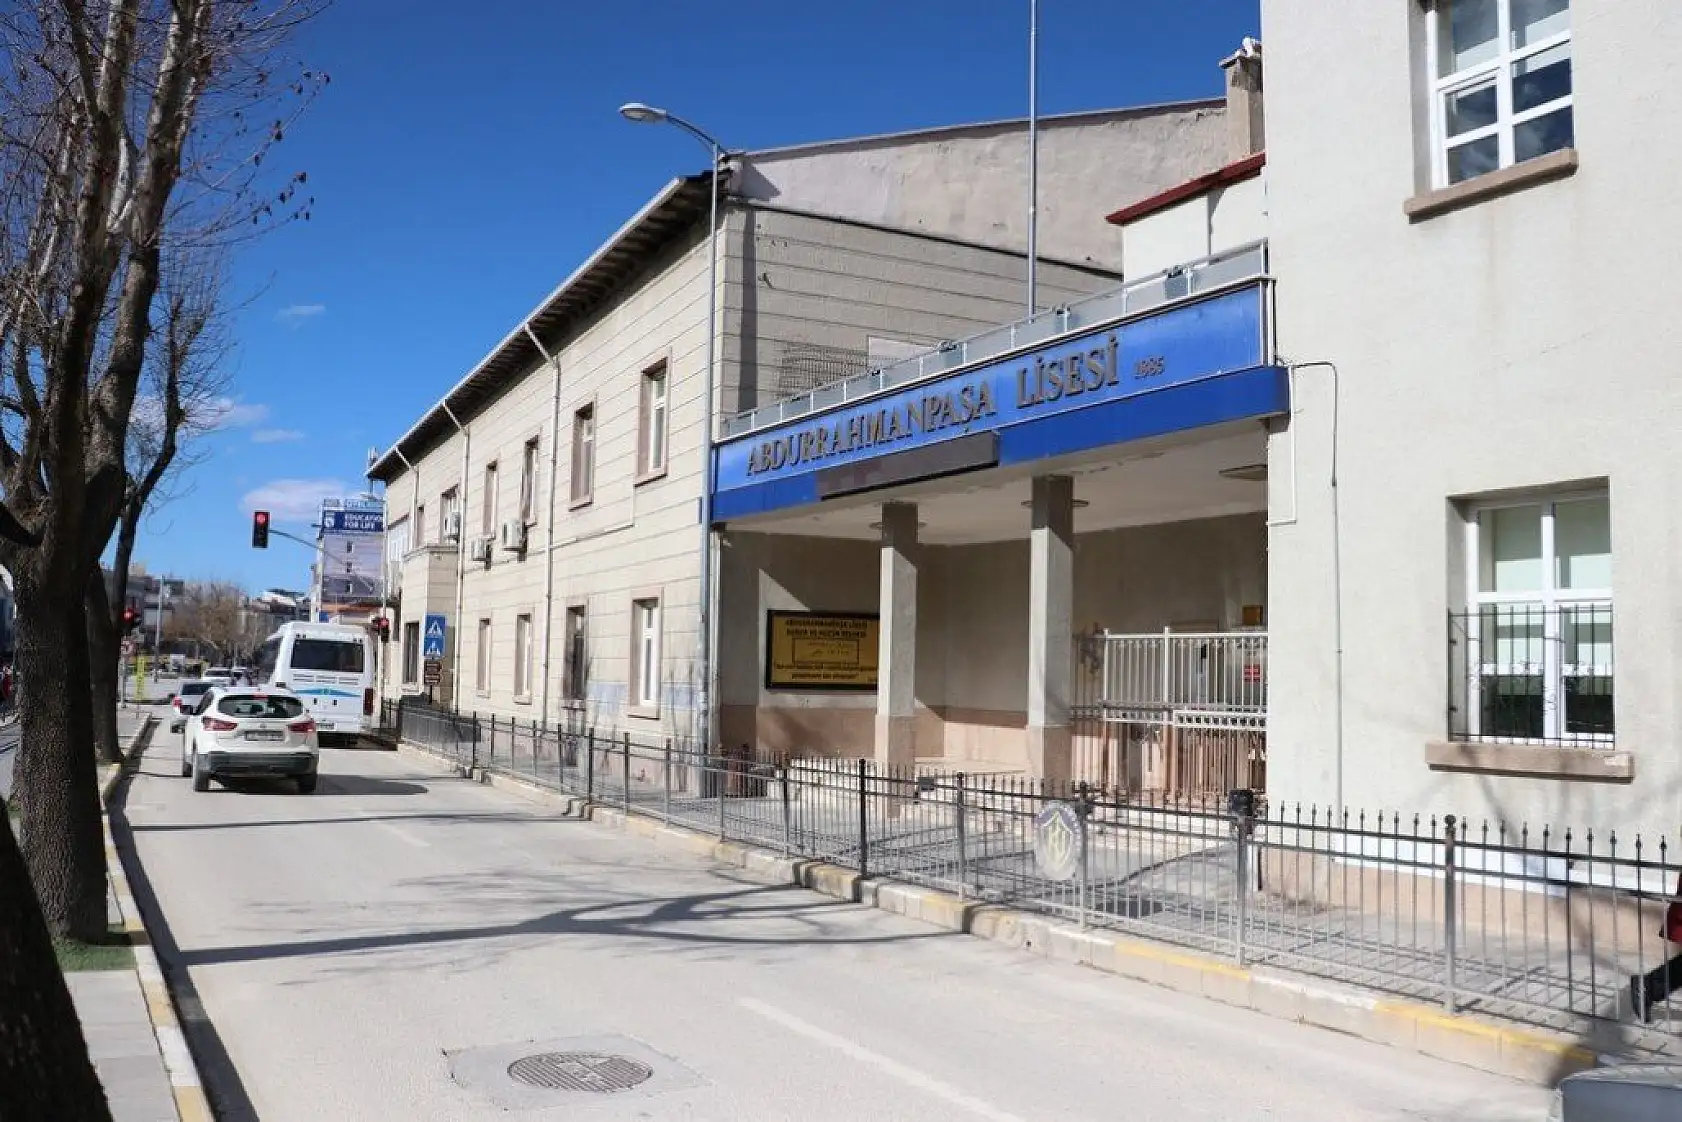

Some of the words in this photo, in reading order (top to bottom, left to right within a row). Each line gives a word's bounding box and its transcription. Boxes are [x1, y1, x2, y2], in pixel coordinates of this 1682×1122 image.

[747, 380, 997, 476] ABDURRAHMANPAŞA
[1016, 334, 1120, 410] LİSESİ
[344, 520, 359, 529] FOR
[361, 520, 375, 529] LIFE
